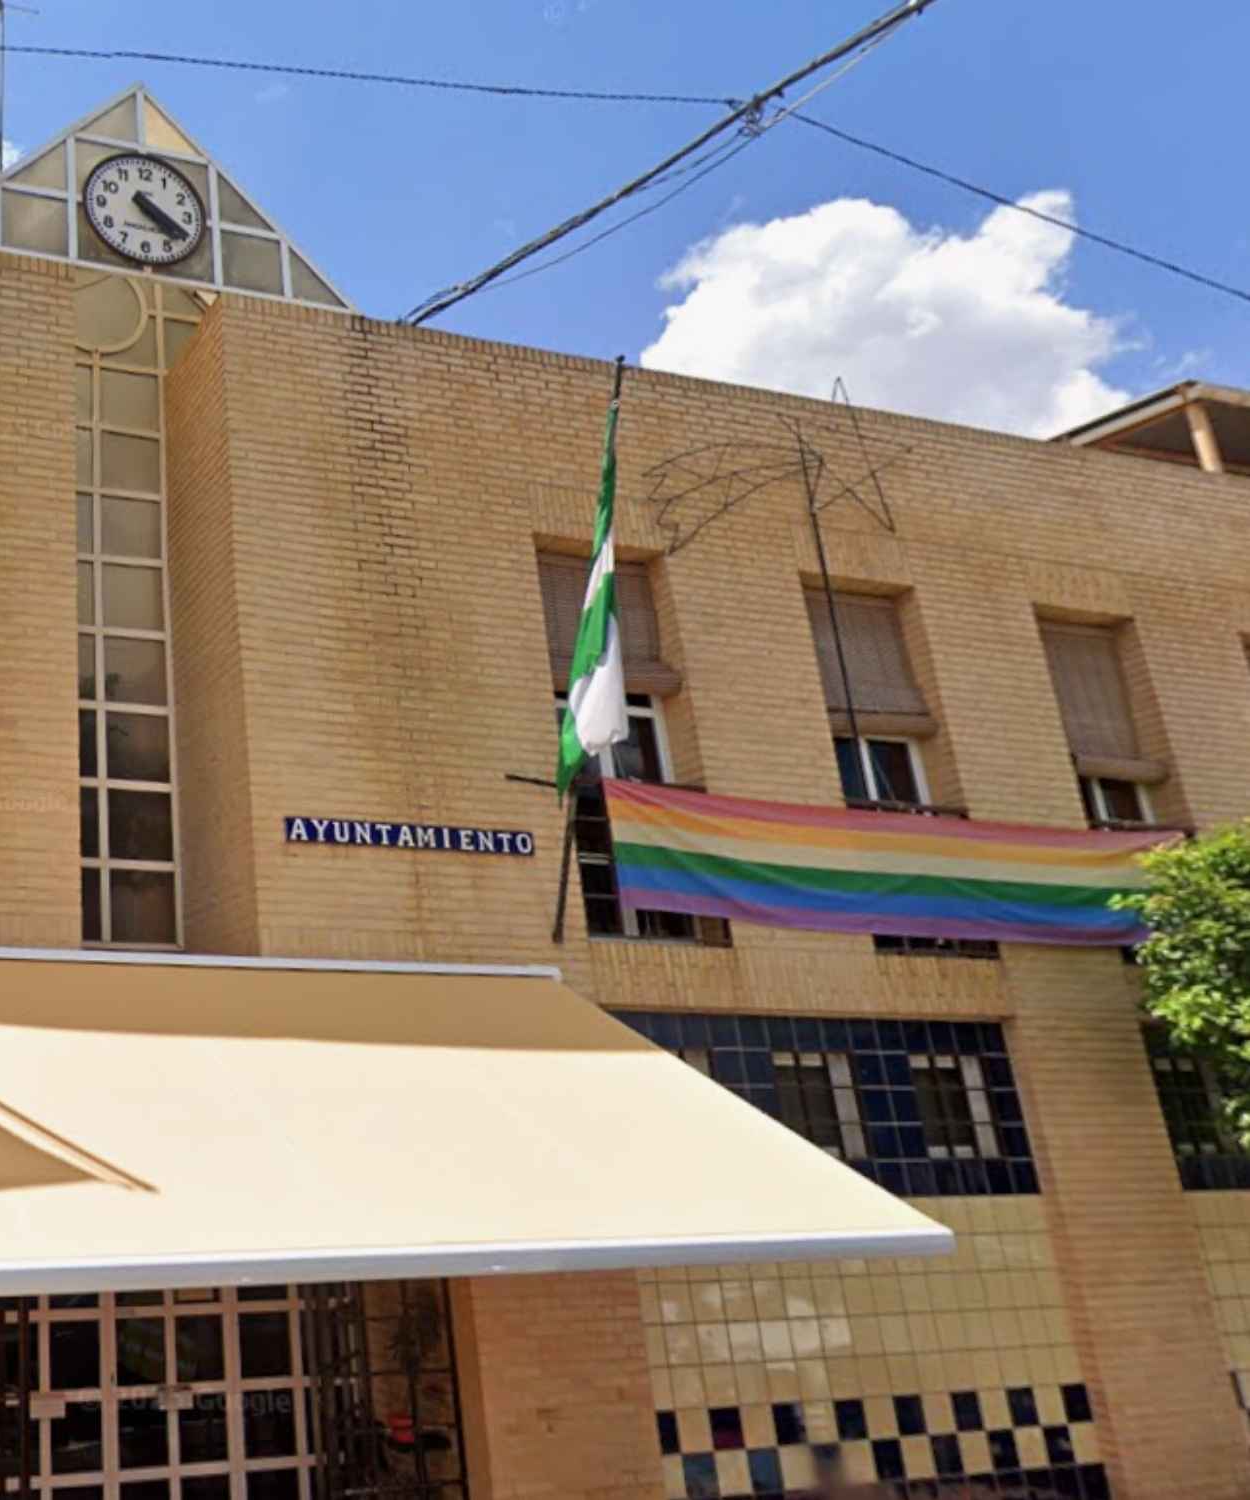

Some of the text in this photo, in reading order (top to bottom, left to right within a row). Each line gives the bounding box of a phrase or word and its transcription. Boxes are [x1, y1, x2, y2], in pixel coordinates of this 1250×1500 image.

[118, 168, 129, 182] 11
[139, 168, 153, 182] 12
[102, 181, 119, 194] 10
[161, 177, 167, 190] 1
[97, 195, 107, 207] 9
[176, 193, 186, 206] 2
[104, 216, 114, 228] 8
[183, 212, 193, 225] 3
[119, 231, 128, 244] 7
[141, 242, 151, 253] 6
[163, 241, 173, 252] 5
[290, 818, 533, 854] AYUNTAMIENTO
